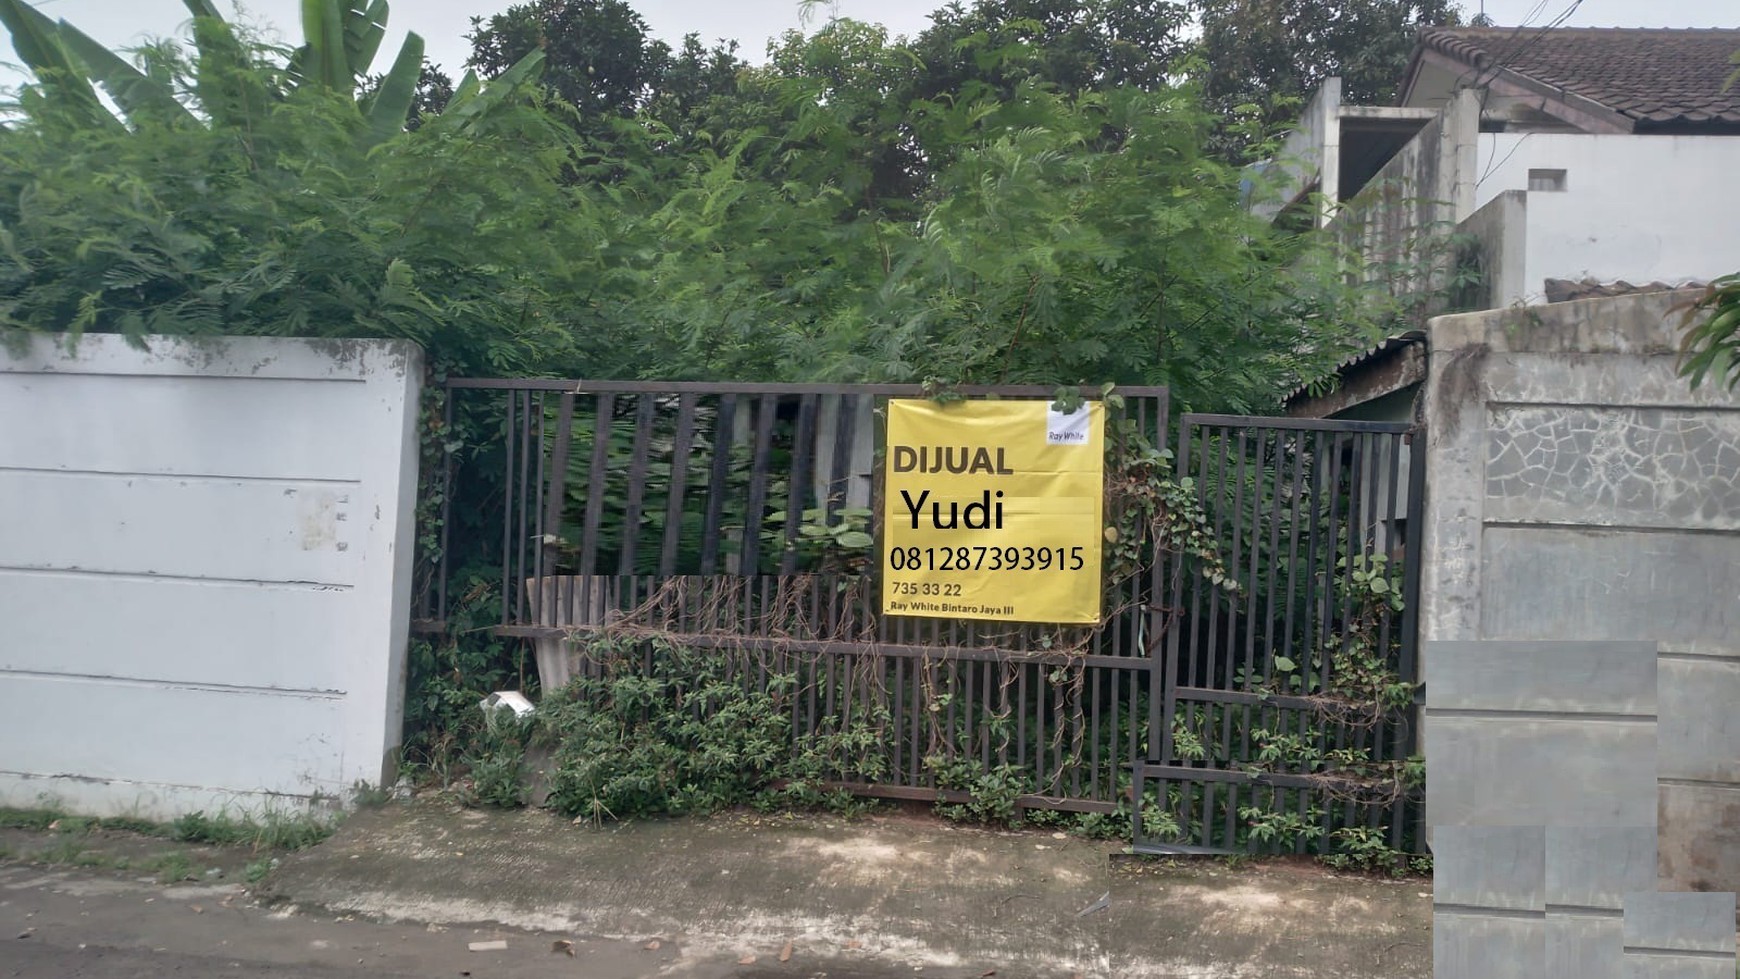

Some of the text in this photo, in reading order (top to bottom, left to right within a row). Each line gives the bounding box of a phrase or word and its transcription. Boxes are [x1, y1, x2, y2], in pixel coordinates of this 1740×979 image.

[1049, 432, 1083, 441] Ray White
[893, 446, 1014, 475] DIJUAL
[892, 582, 962, 596] 735 33 22
[891, 602, 1014, 615] Ray White Bintaro Jaya III
